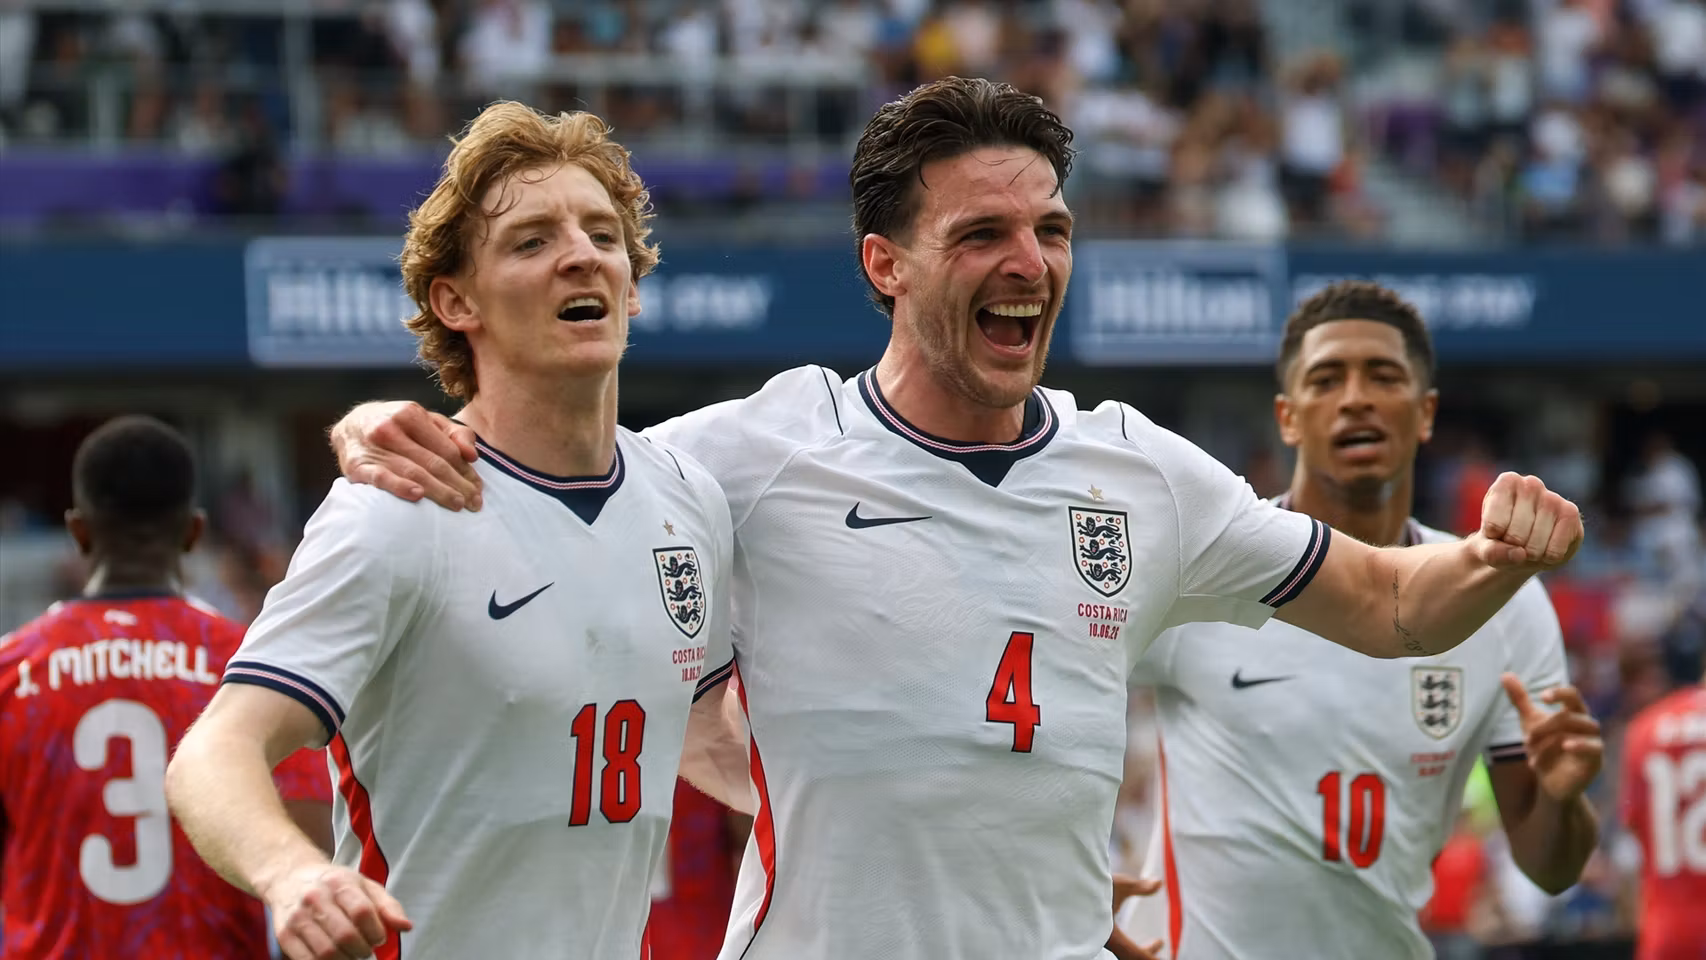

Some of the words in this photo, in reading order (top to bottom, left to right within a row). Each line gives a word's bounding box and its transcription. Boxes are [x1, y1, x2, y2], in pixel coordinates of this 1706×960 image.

[672, 648, 695, 664] COSTA
[1078, 603, 1111, 620] COSTA
[49, 638, 218, 690] MITCHELL
[986, 631, 1041, 753] 4
[74, 699, 173, 905] 3
[568, 699, 646, 827] 18
[1316, 771, 1386, 869] 10
